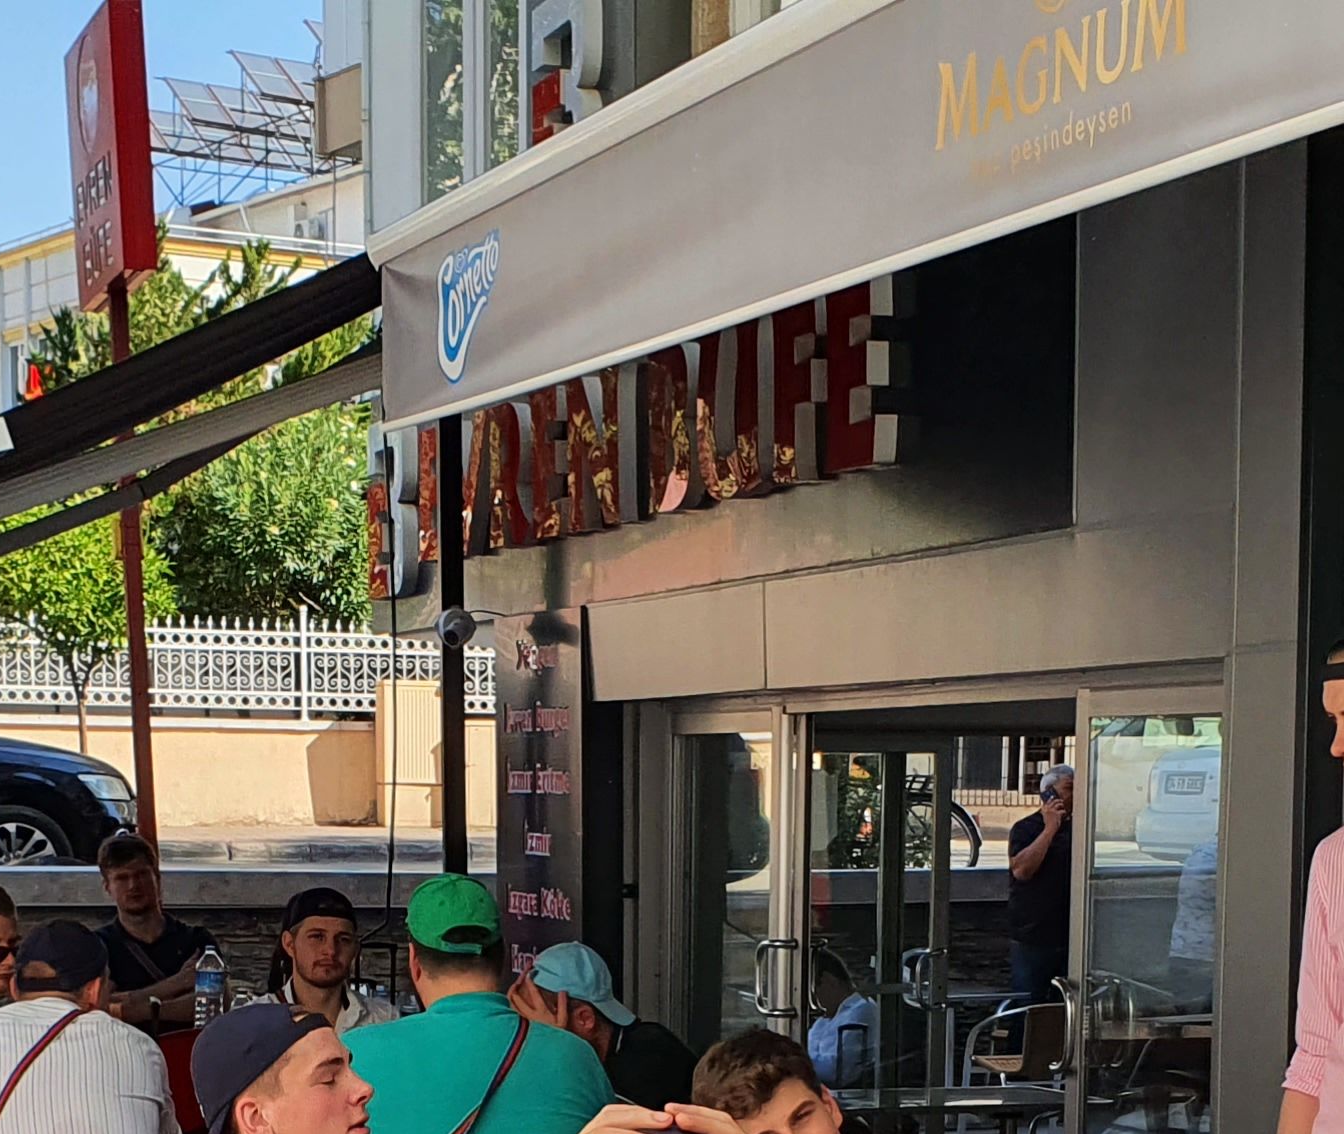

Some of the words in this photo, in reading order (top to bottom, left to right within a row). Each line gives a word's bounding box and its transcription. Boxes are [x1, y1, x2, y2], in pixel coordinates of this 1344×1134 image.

[935, 0, 1189, 151] MAGNUM
[77, 150, 113, 231] EVREN
[437, 232, 500, 383] Cornetto
